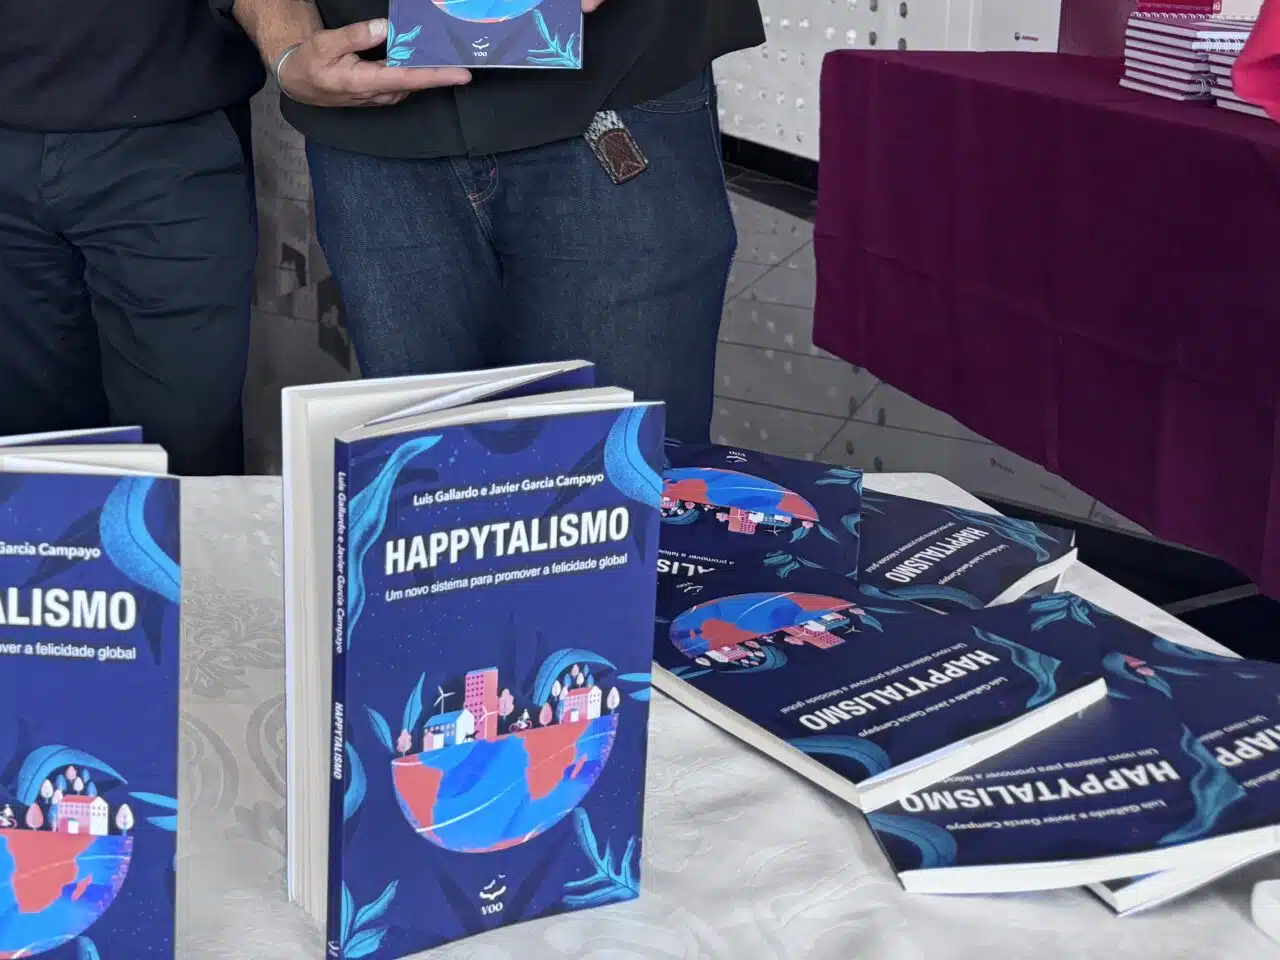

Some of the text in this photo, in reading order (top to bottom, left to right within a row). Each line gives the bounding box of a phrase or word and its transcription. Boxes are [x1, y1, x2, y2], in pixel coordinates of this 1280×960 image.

[413, 493, 433, 506] Luis
[434, 486, 478, 502] Gallardo
[480, 487, 487, 496] e
[489, 482, 520, 495] Javier
[556, 473, 604, 487] Campayo
[37, 542, 101, 560] Campayo
[385, 507, 628, 575] HAPPYTALISMO
[884, 526, 990, 583] HAPPYTALISMO
[385, 553, 627, 602] Um novo sistema para promover a felicidade global
[23, 644, 33, 654] a
[35, 642, 95, 657] felicidade
[97, 646, 136, 660] global
[799, 650, 1000, 730] HAPPYTALISMO
[333, 702, 343, 779] HAPPYTALISMO
[899, 759, 1180, 813] HAPPYTALISMO
[481, 901, 503, 915] VOO
